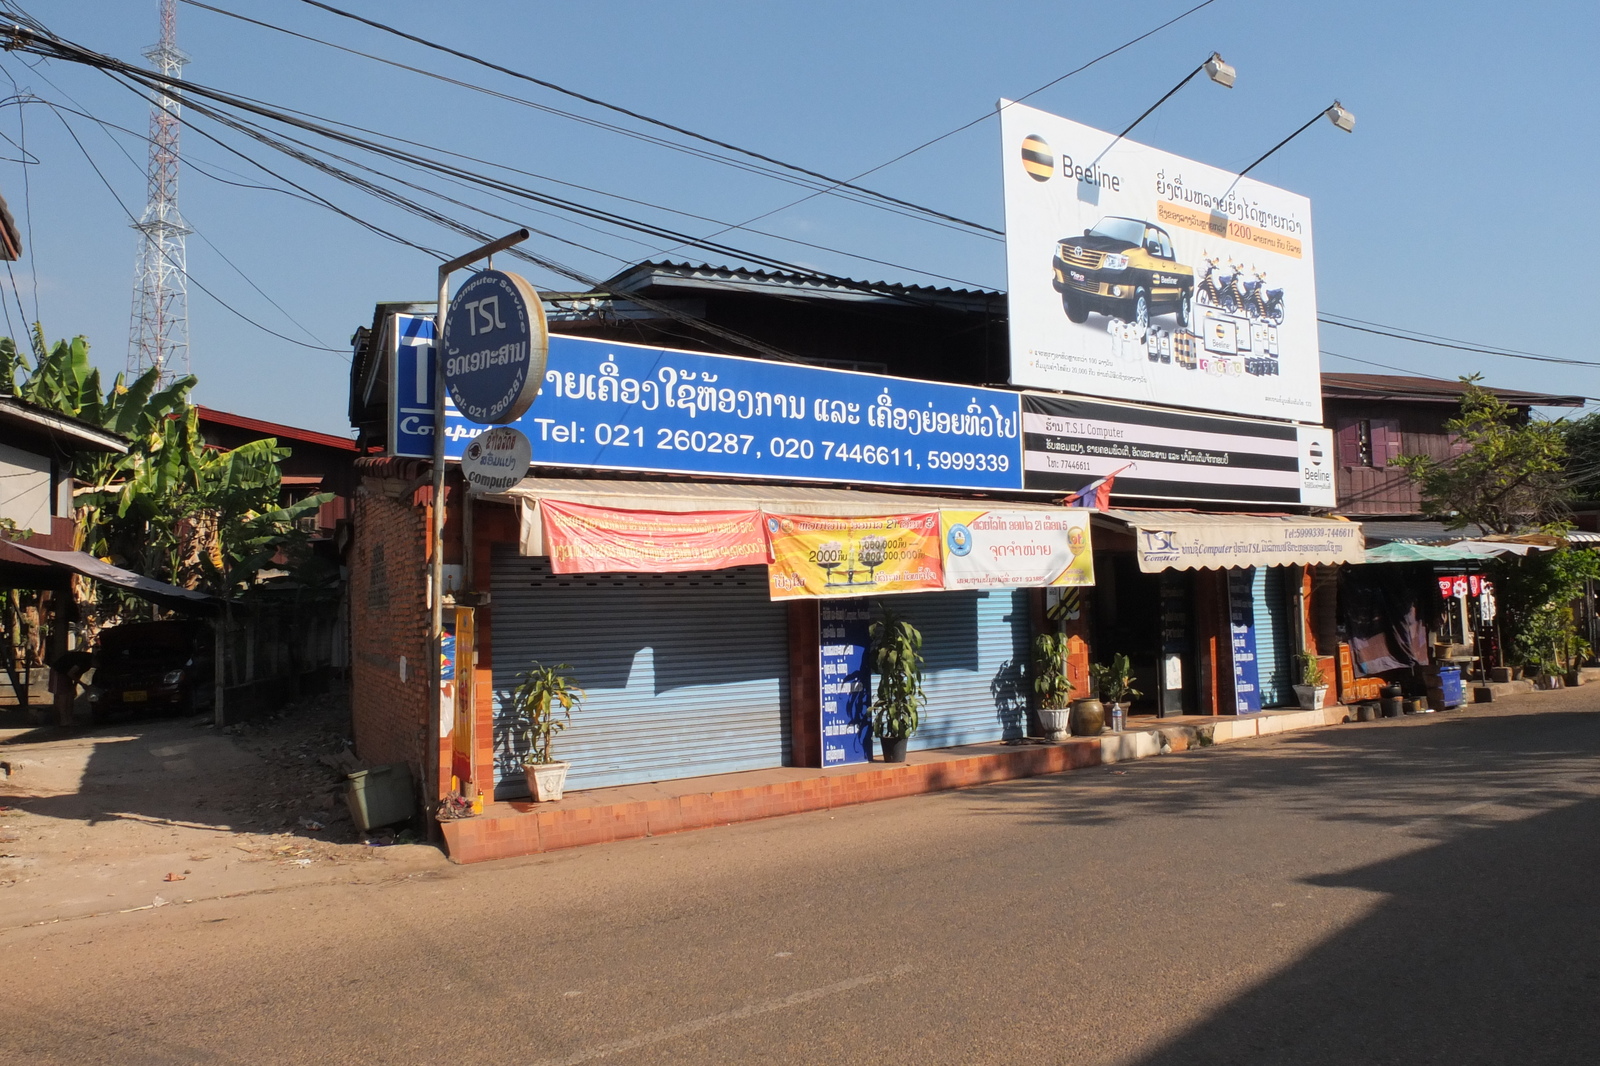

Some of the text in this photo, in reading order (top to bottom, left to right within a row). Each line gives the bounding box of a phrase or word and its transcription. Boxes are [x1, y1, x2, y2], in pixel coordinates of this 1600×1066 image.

[1062, 153, 1120, 193] Beeline
[1228, 222, 1251, 241] 1200
[452, 276, 499, 312] Computer
[499, 279, 526, 334] Service
[465, 295, 507, 337] TSL
[451, 368, 524, 418] Tel: 021 260287
[814, 398, 860, 425] ແລະ
[534, 417, 1009, 472] Tel: 021 260287, 020 7446611, 5999339
[1087, 423, 1124, 439] Computer
[1304, 467, 1330, 482] Beeline
[1035, 521, 1042, 531] 21
[1062, 520, 1068, 531] 5
